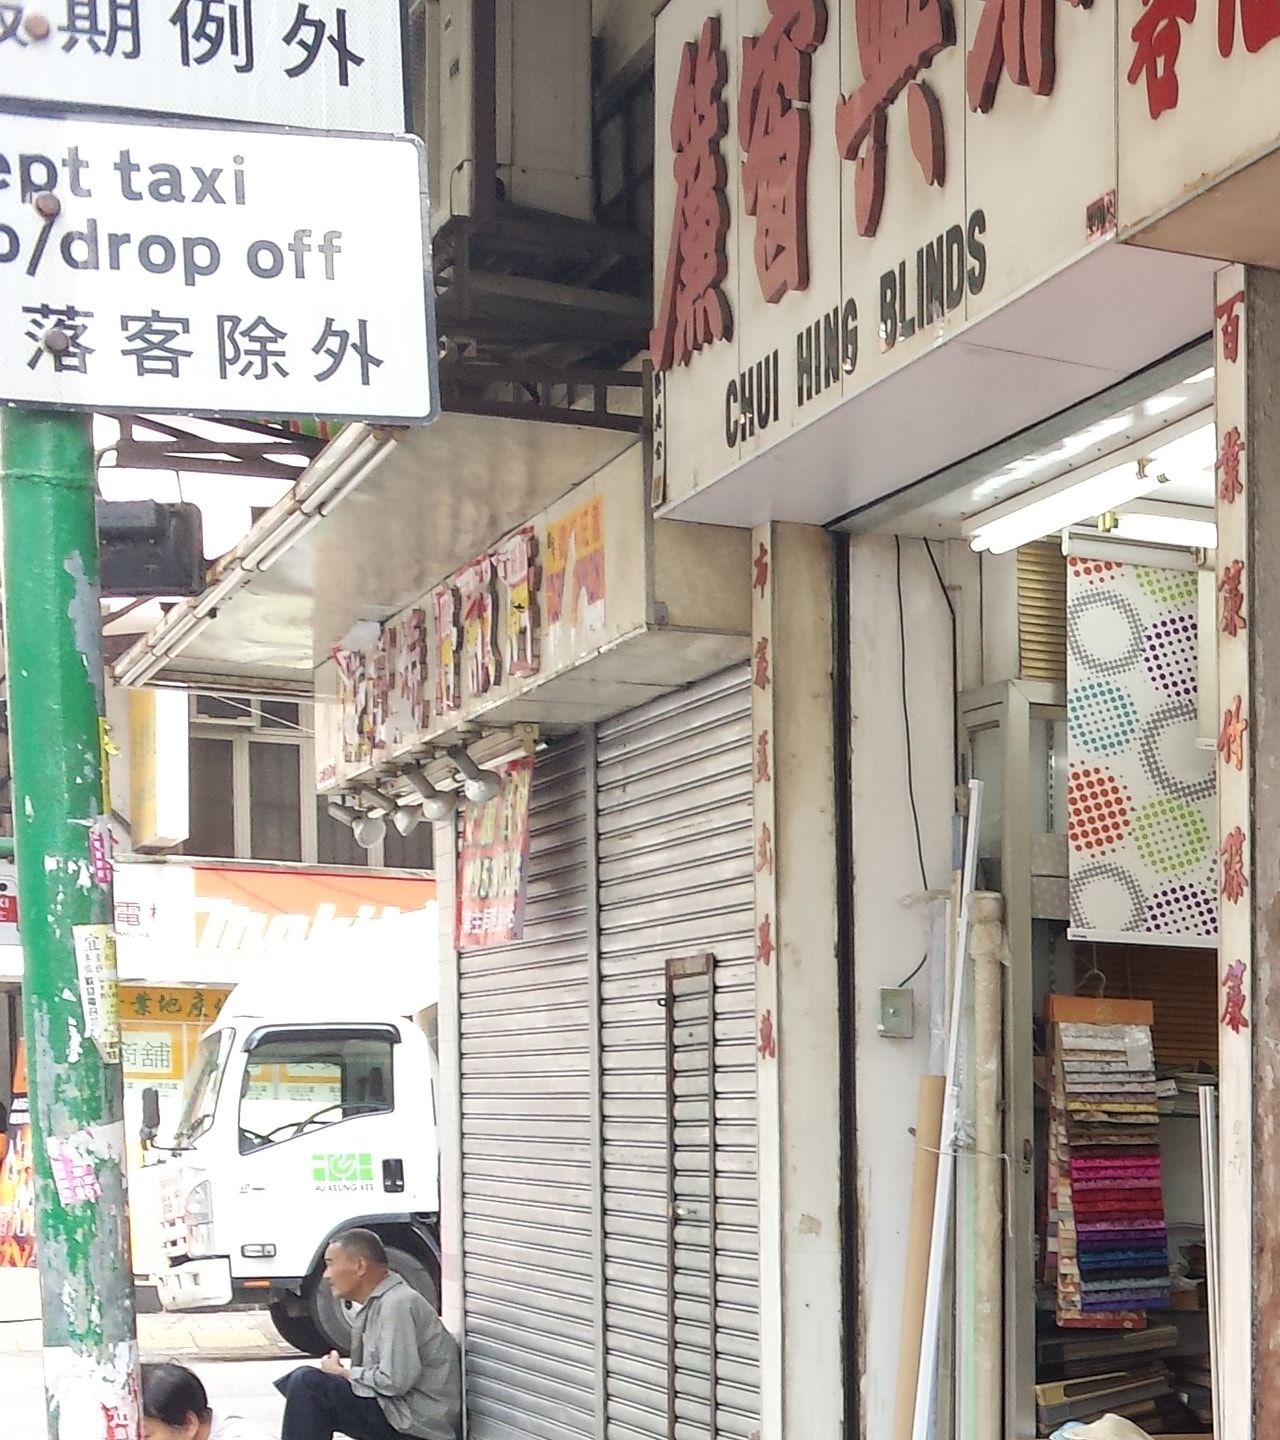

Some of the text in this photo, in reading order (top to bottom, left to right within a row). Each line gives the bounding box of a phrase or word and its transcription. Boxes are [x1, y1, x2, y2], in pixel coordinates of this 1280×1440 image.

[113, 148, 247, 206] taxi
[246, 229, 343, 281] off
[21, 302, 385, 387] 落客除外
[726, 379, 780, 449] CHUI
[796, 297, 859, 408] HING
[879, 208, 987, 355] BLINDS
